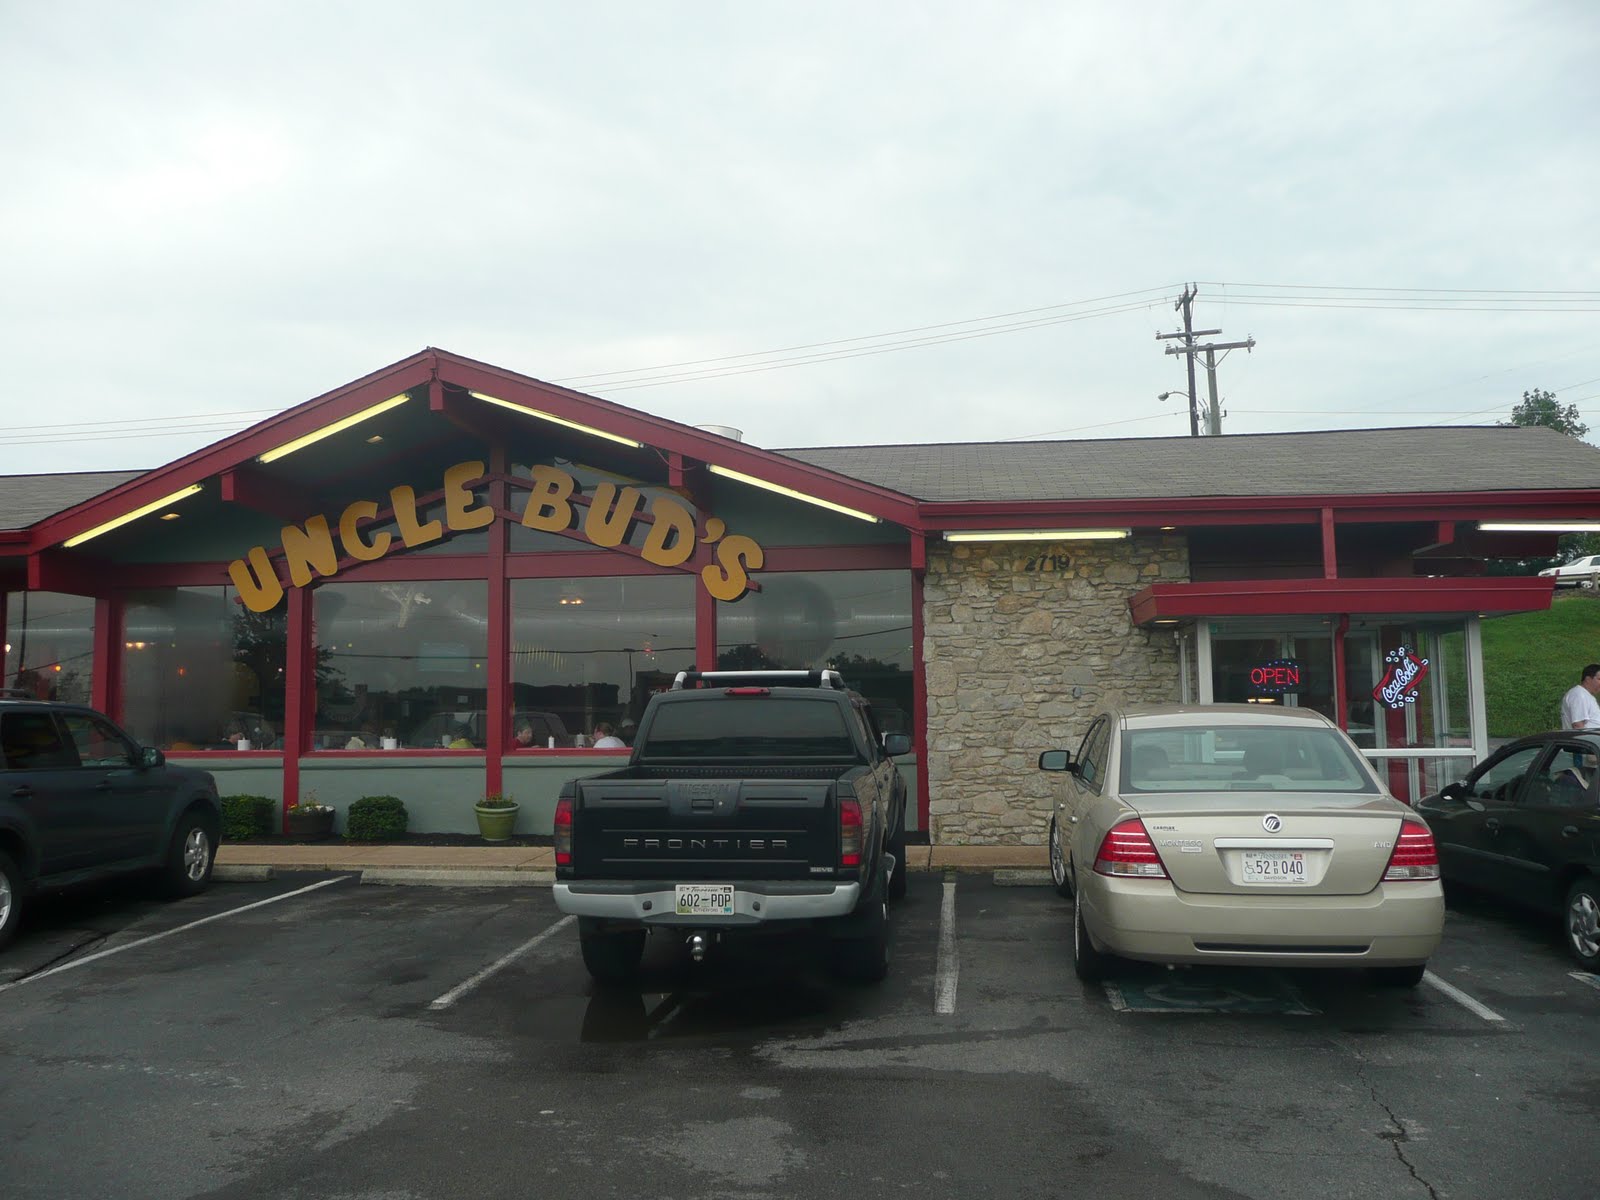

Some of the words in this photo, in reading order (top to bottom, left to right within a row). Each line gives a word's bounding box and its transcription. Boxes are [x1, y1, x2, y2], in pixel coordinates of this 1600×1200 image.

[228, 460, 495, 613] UNCLE
[521, 464, 764, 601] BUD'S
[1250, 667, 1300, 685] OPEN
[623, 838, 788, 849] FRONTIER
[1256, 860, 1271, 874] 52
[1281, 860, 1303, 875] 040
